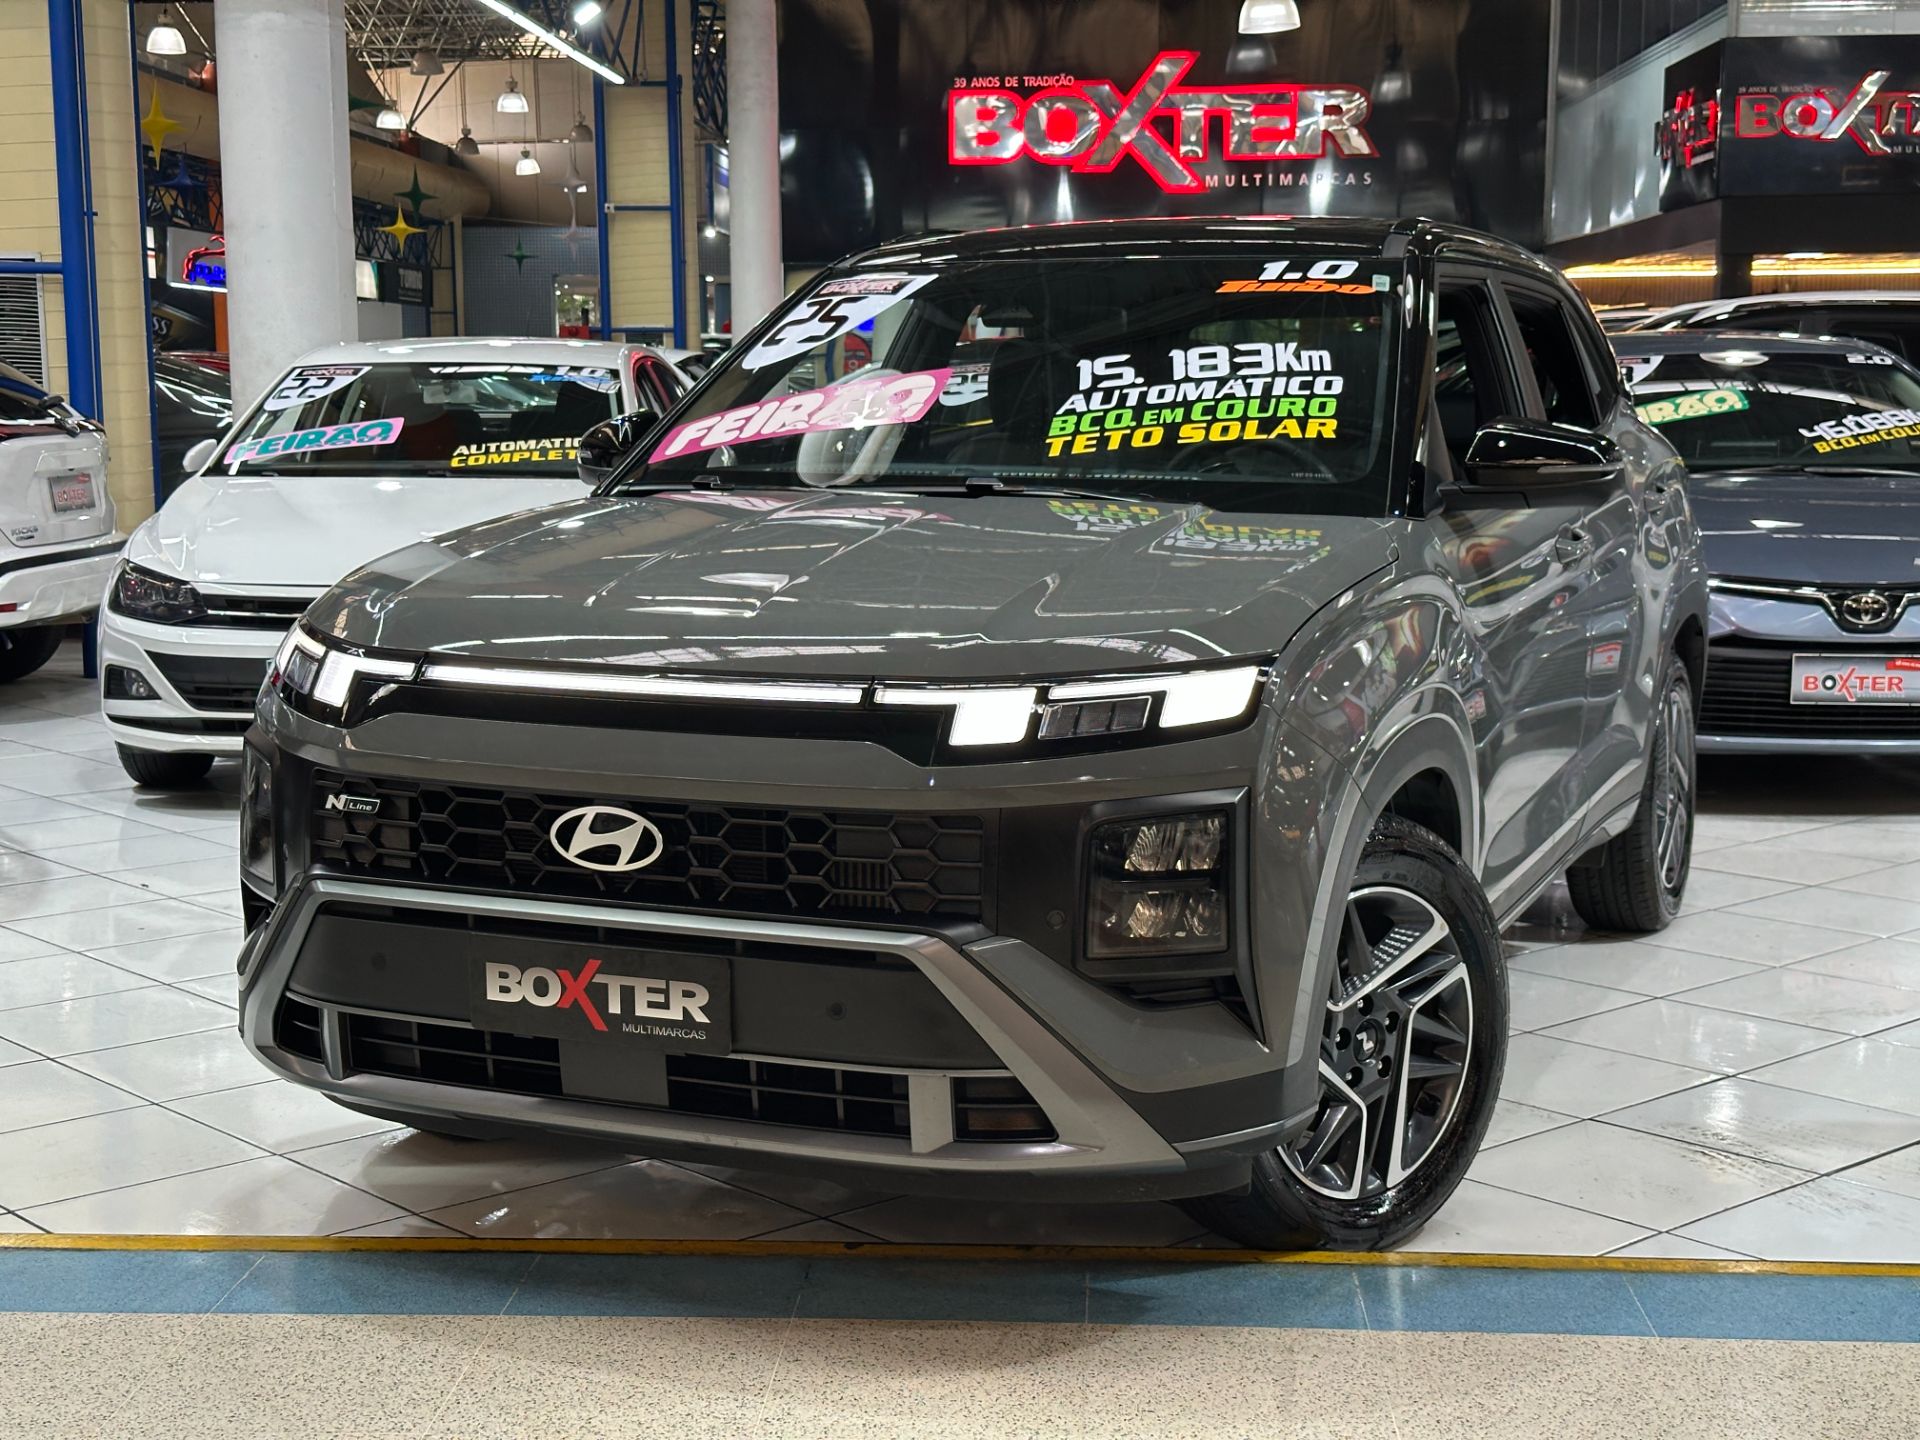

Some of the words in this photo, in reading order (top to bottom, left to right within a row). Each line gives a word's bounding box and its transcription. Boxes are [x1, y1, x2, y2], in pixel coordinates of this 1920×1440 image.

[953, 78, 967, 88] 39
[970, 76, 1000, 88] ANOS
[1004, 76, 1019, 87] DE
[1023, 73, 1075, 88] TRADIÇÃO
[948, 50, 1380, 193] BOXTER
[1735, 70, 1920, 156] BOXT
[1204, 172, 1373, 187] MULTIMARCAS
[1258, 260, 1359, 281] 1.0
[762, 296, 870, 346] 25
[1846, 353, 1893, 365] 2.0
[1142, 407, 1184, 425] EM
[1190, 398, 1338, 421] COURO
[1046, 427, 1164, 457] TETO
[1177, 419, 1338, 444] SOLAR
[1858, 434, 1881, 445] EM
[1879, 425, 1920, 440] COU
[1802, 665, 1905, 702] BOXTER
[325, 794, 347, 811] N
[349, 802, 373, 811] Line
[485, 959, 711, 1031] BOXTER
[622, 1022, 706, 1040] MULTIMARCAS
